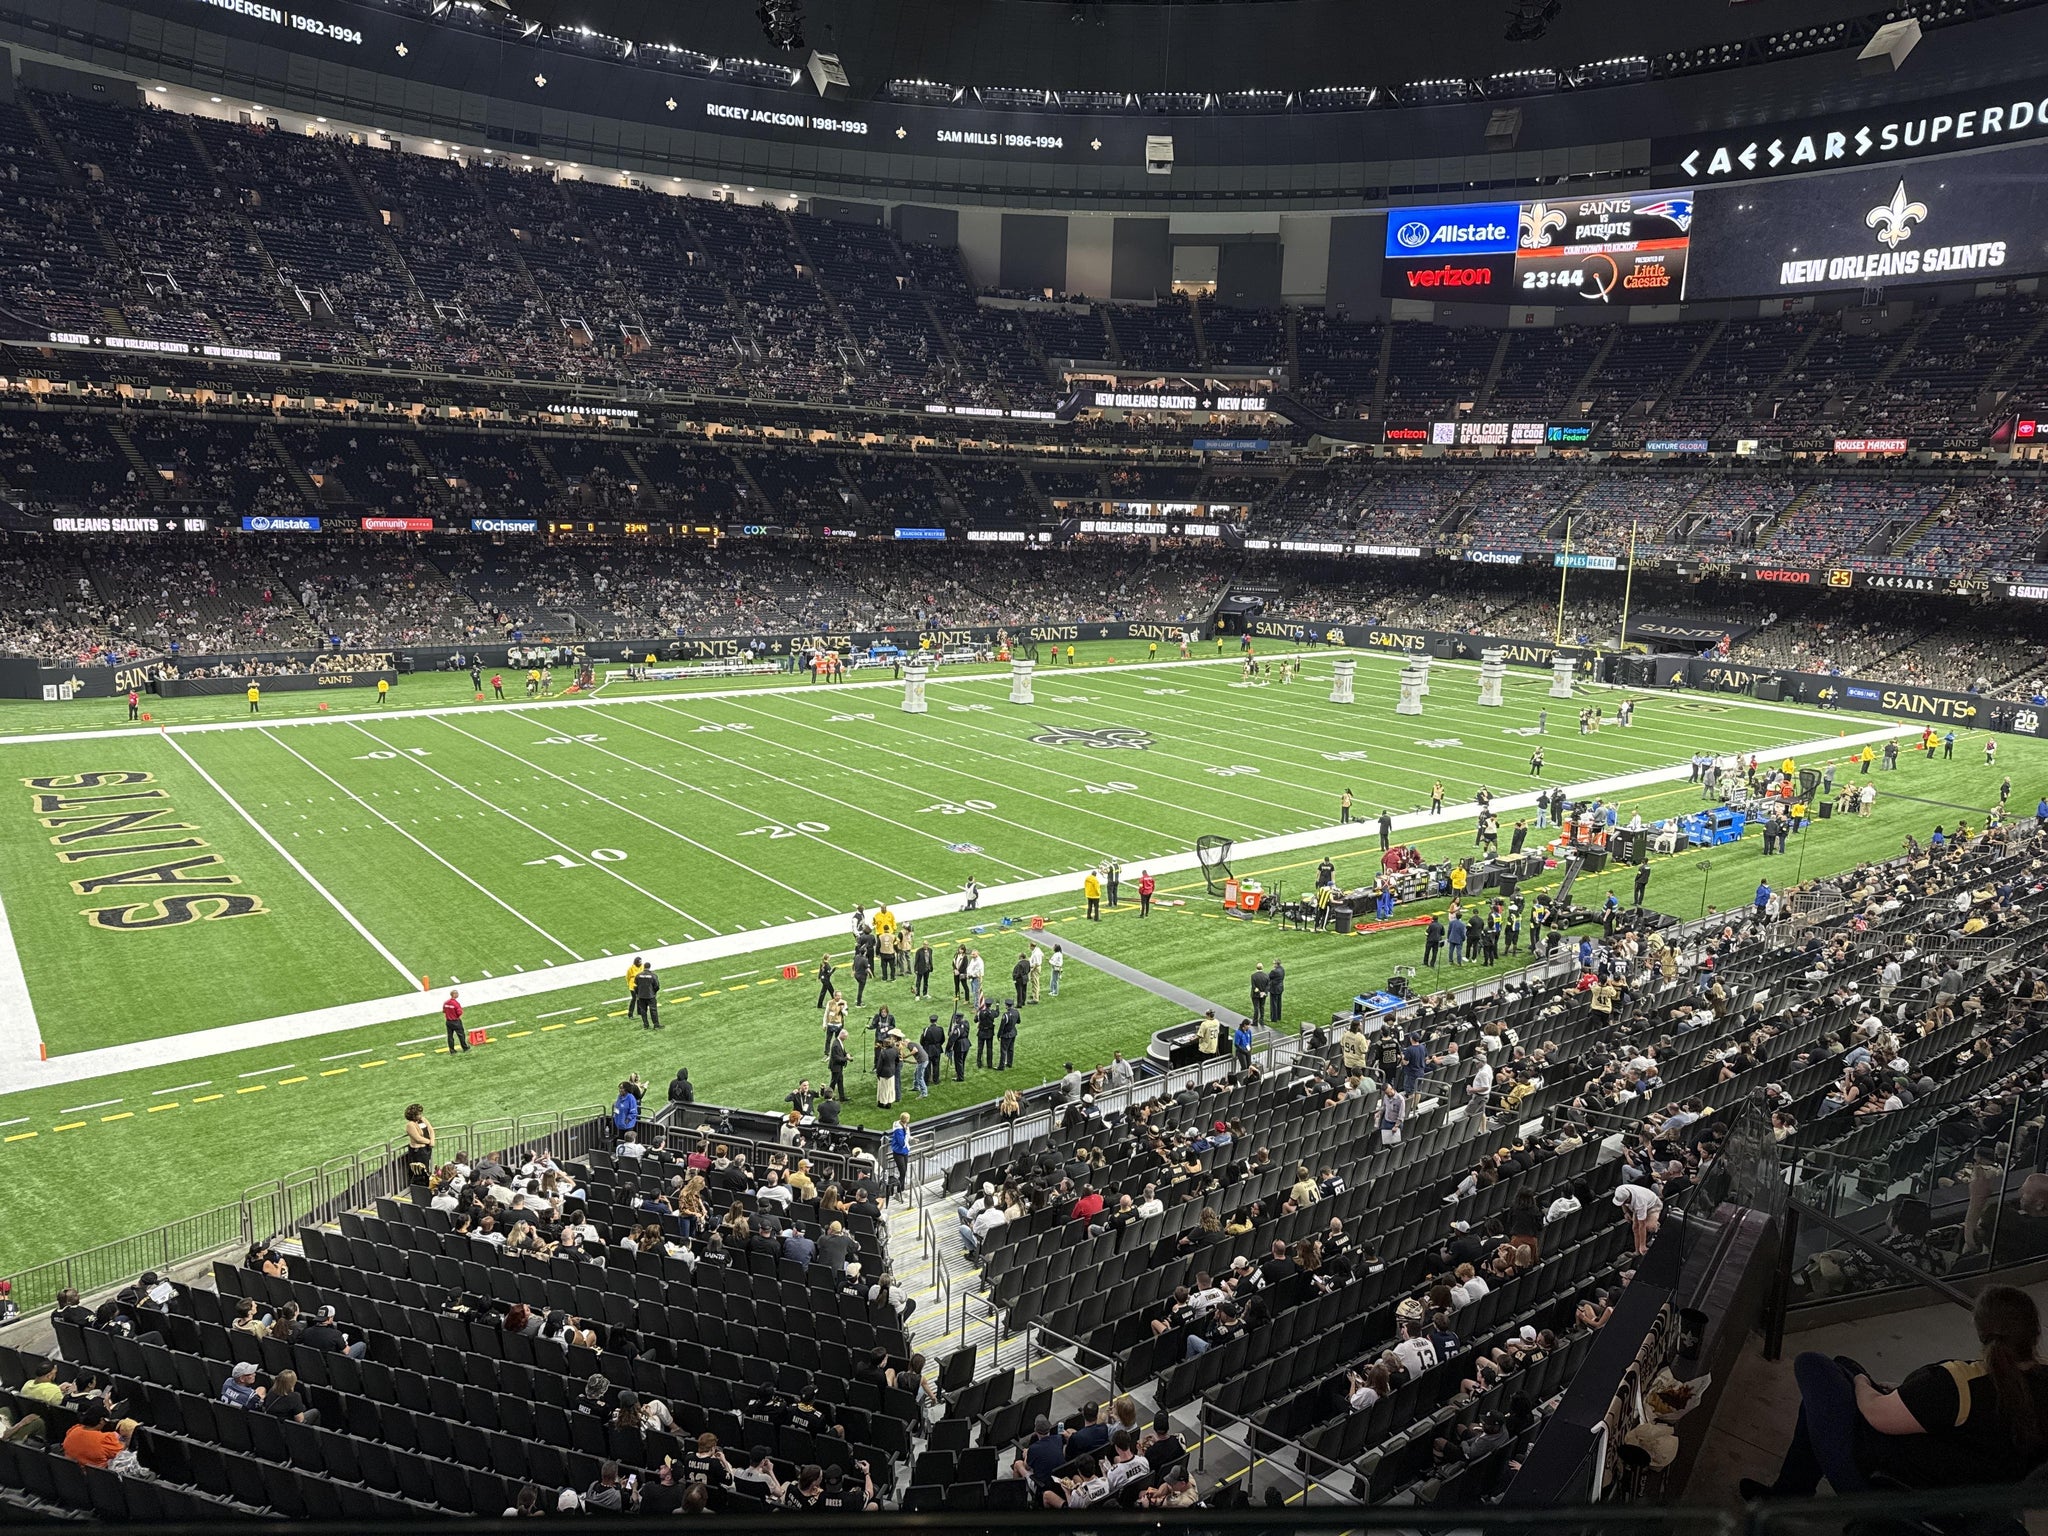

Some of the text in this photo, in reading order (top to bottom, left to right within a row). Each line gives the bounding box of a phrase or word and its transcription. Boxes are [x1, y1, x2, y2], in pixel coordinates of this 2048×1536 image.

[290, 14, 363, 45] 1982-1994
[706, 103, 868, 135] RICKEY JACKSON 1981-1993
[936, 130, 1064, 149] SAM MILLS 1986-1994
[1681, 125, 1873, 177] CAESARS
[1579, 200, 1630, 216] SAINTS
[1575, 222, 1631, 238] PATRIOTS
[1564, 242, 1639, 255] COUNTDOWN TO KICKOFF
[1780, 242, 2006, 285] NEW ORLEANS SAINTS
[1407, 265, 1491, 287] verizon
[1634, 264, 1666, 277] Little
[1523, 270, 1585, 289] 23:44
[1623, 272, 1671, 289] Caesars
[57, 334, 90, 345] SAINTS
[106, 337, 189, 353] NEW ORLEANS SAINTS
[204, 346, 281, 362] NEW ORLEANS SAINTS
[332, 356, 368, 367] SAINTS
[19, 368, 61, 379] SAINTS
[410, 363, 445, 373] SAINTS
[109, 374, 149, 385] SAINTS
[484, 369, 516, 379] SAINTS
[555, 375, 586, 384] SAINTS
[196, 380, 233, 391] SAINTS
[275, 386, 311, 396] SAINTS
[687, 386, 716, 395] SAINTS
[352, 391, 384, 401] SAINTS
[422, 396, 453, 405] SAINTS
[749, 391, 776, 400] SAINTS
[807, 395, 834, 404] SAINTS
[490, 401, 520, 410] SAINTS
[865, 400, 890, 408] SAINTS
[1095, 393, 1115, 406] NEW
[1115, 394, 1158, 408] ORLEANS
[1159, 396, 1197, 409] SAINTS
[1217, 398, 1240, 411] NEW
[591, 407, 639, 418] SUPERDOME
[661, 412, 688, 421] SAINTS
[1387, 428, 1427, 440] verizon
[1460, 423, 1509, 435] FAN CODE
[1511, 430, 1544, 439] QR CODE
[1460, 434, 1508, 444] OF CONDUCT
[1612, 440, 1640, 448] SAINTS
[1793, 440, 1825, 449] SAINTS
[1943, 439, 1979, 448] SAINTS
[1835, 441, 1905, 450] ROUSES MARKETS
[53, 518, 159, 532] ORLEANS SAINTS
[323, 519, 358, 528] SAINTS
[366, 518, 407, 530] Community
[482, 520, 535, 532] Ochsner
[1095, 522, 1203, 535] ORLEANS SAINTS NEW
[744, 526, 767, 535] COX
[967, 532, 1025, 541] ORLEANS SAINTS
[1280, 542, 1343, 553] NEW ORLEANS SAINTS
[1354, 545, 1420, 556] NEW ORLEANS SAINTS
[1435, 548, 1461, 556] SAINTS
[1473, 551, 1521, 564] Ochsner
[1556, 556, 1586, 566] PEOPLES
[1588, 558, 1614, 568] HEALTH
[1698, 562, 1730, 571] SAINTS
[1756, 569, 1810, 583] verizon
[1832, 571, 1849, 584] 25
[1867, 576, 1933, 590] CAESARS
[1949, 579, 1988, 590] SAINTS
[1030, 626, 1078, 641] SAINTS
[1256, 621, 1304, 637] SAINTS
[1638, 623, 1725, 637] SAINTS
[318, 675, 353, 685] SAINTS
[1882, 691, 1968, 718] SAINTS
[2014, 712, 2038, 730] 20
[1085, 781, 1138, 794] 40
[930, 799, 997, 815] 30
[754, 821, 831, 839] 20
[19, 771, 271, 931] SAINTS
[544, 848, 628, 869] 10
[1246, 895, 1256, 905] G
[703, 1250, 726, 1261] SAINTS
[1416, 1350, 1434, 1370] 13
[688, 1460, 710, 1471] COLSTON
[1125, 1465, 1142, 1479] BREES
[825, 1498, 843, 1508] BREES
